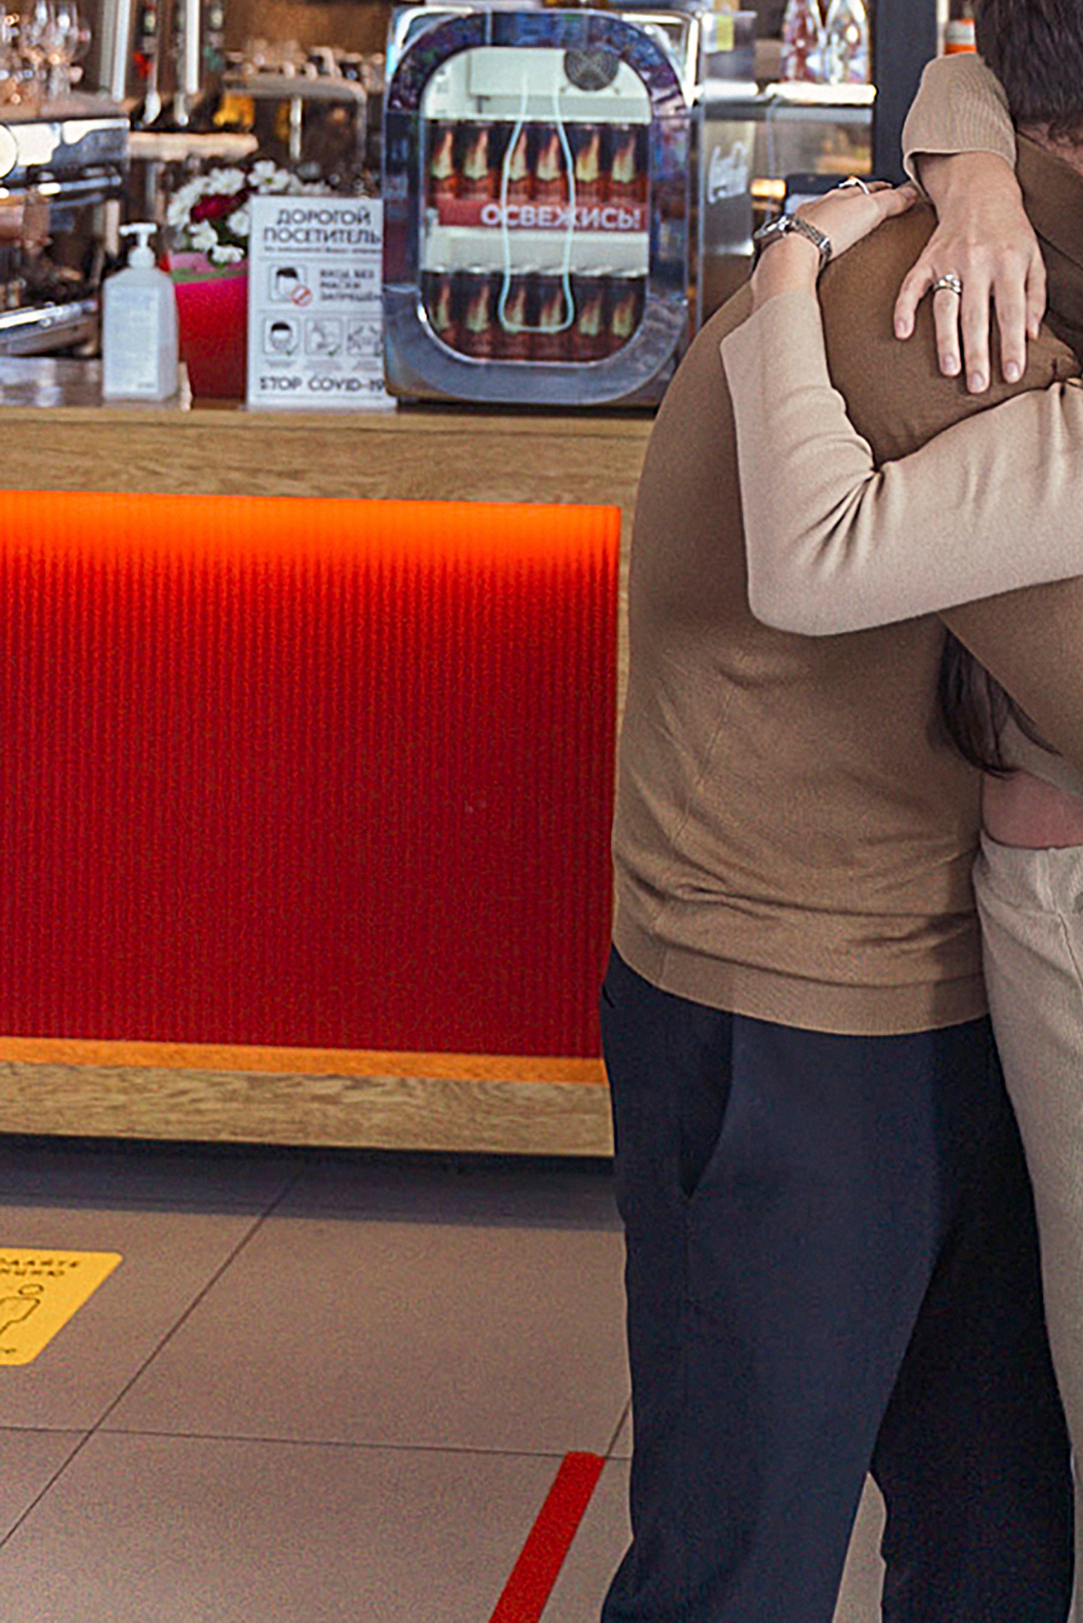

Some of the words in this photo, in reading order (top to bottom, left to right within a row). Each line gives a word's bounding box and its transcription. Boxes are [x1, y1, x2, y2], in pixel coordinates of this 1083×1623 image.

[276, 206, 371, 225] ДОРОГОЙ
[480, 204, 641, 229] ОСВЕЖИСЬ!
[263, 228, 381, 244] ПОСЕТИТЕЛЬ
[260, 377, 302, 390] STOP
